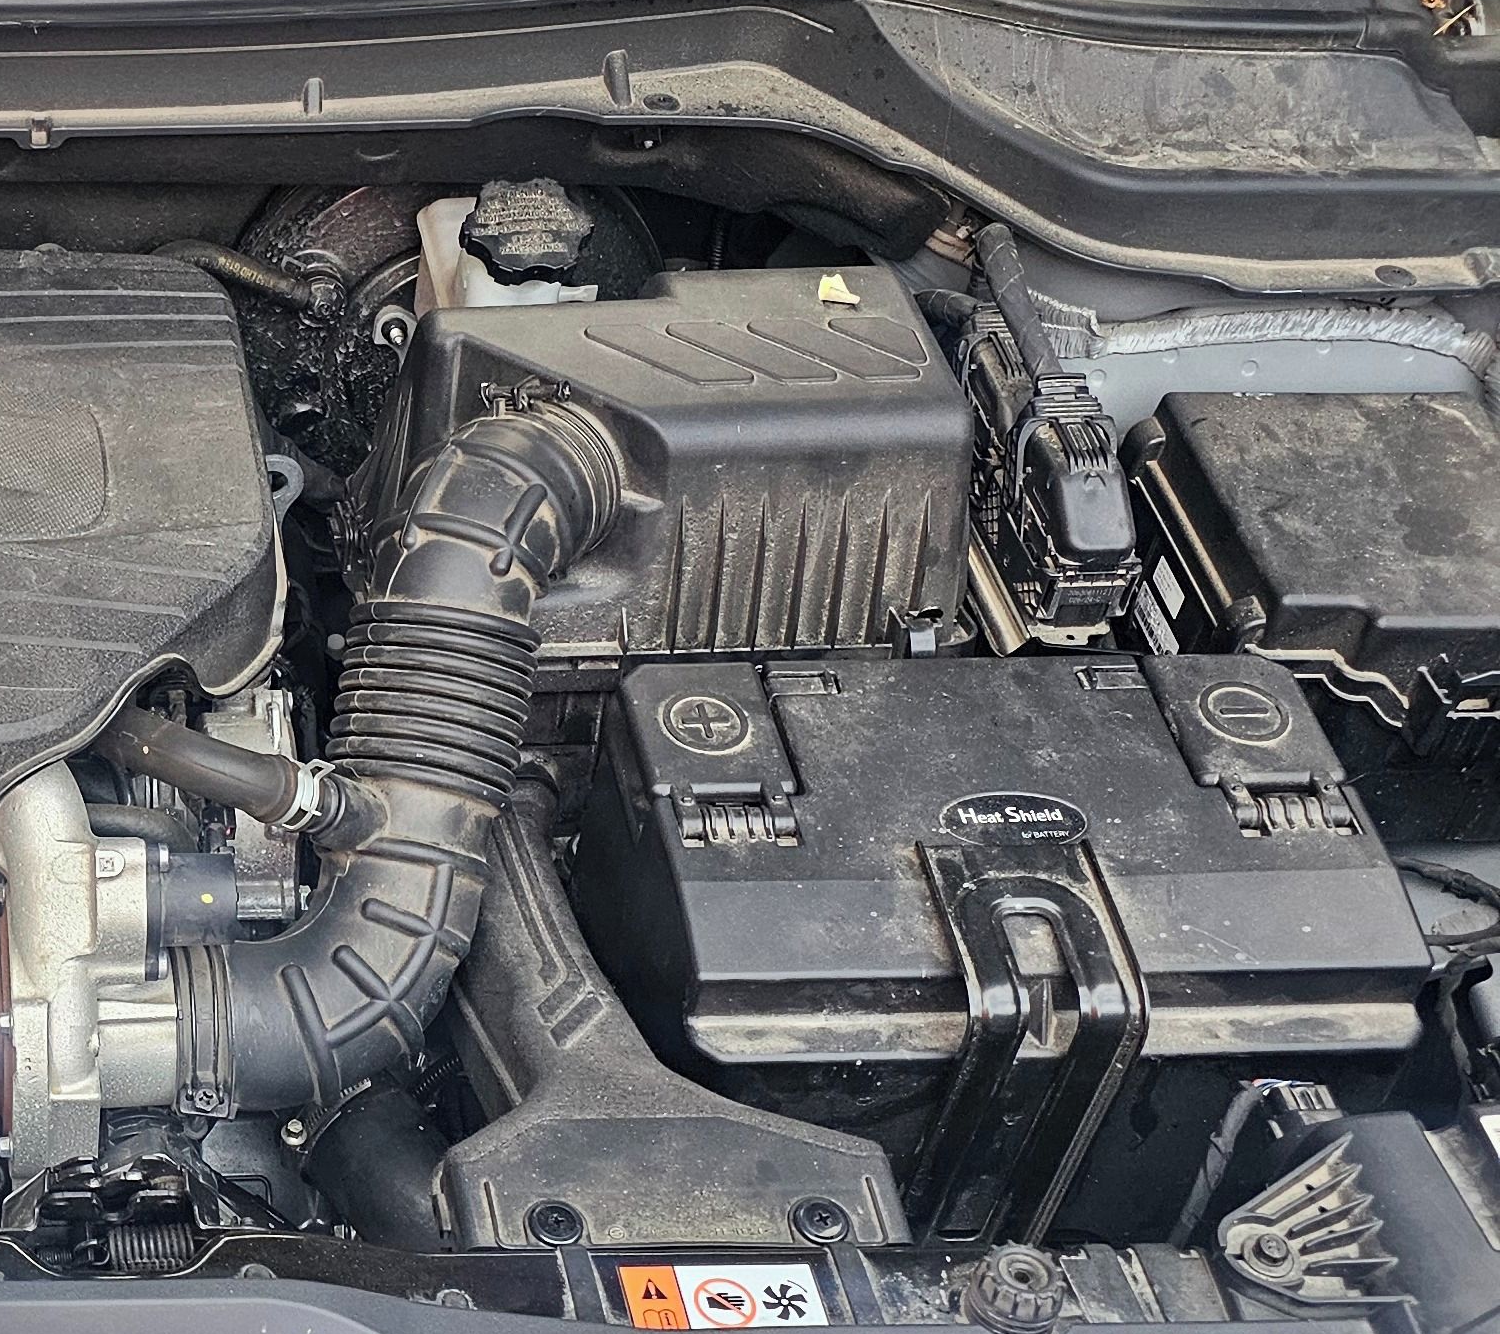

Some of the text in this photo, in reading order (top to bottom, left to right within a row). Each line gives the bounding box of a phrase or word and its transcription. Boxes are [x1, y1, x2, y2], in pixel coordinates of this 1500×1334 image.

[957, 806, 1064, 825] Heat Shield
[1033, 830, 1070, 839] BATTERY
